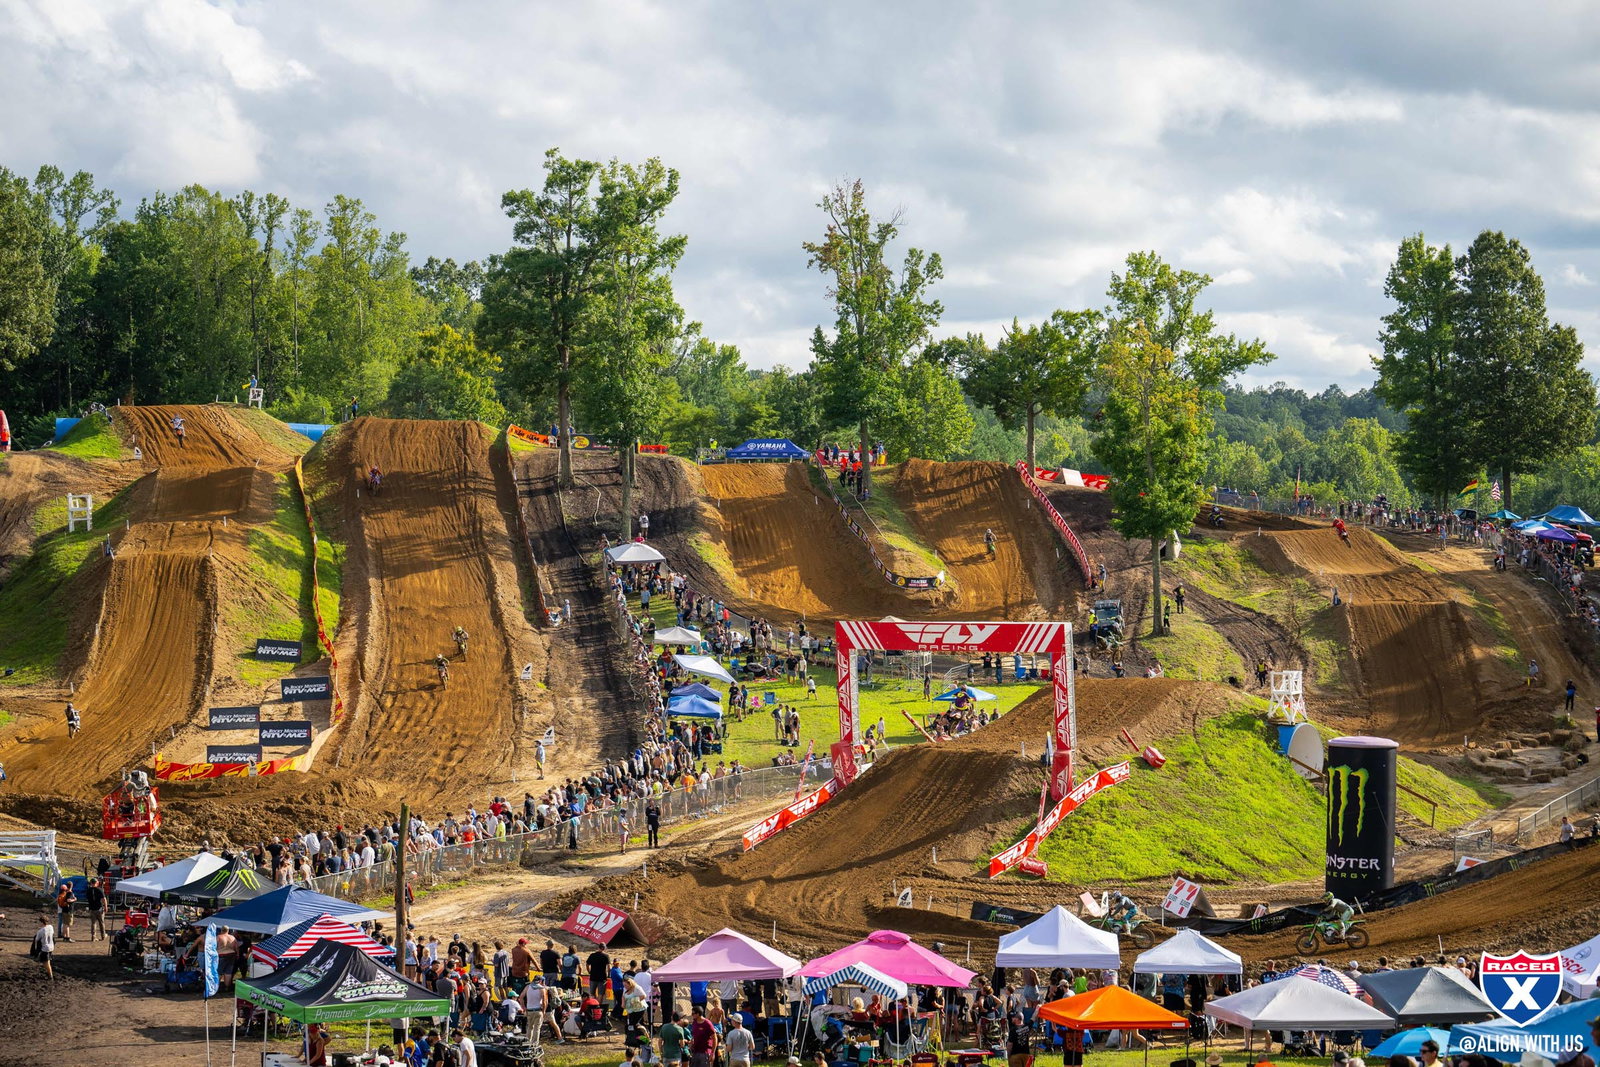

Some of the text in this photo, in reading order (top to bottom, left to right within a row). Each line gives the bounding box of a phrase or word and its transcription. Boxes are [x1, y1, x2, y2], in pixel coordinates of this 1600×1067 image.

[895, 623, 1001, 644] FLY
[787, 791, 820, 816] FLY
[743, 814, 780, 842] FLY
[997, 841, 1028, 864] FLY
[1326, 853, 1381, 871] ONSTER
[1326, 871, 1368, 879] NERGY
[576, 904, 625, 933] FLY
[573, 925, 602, 939] RACING
[314, 1001, 439, 1020] Promoter: David Williams
